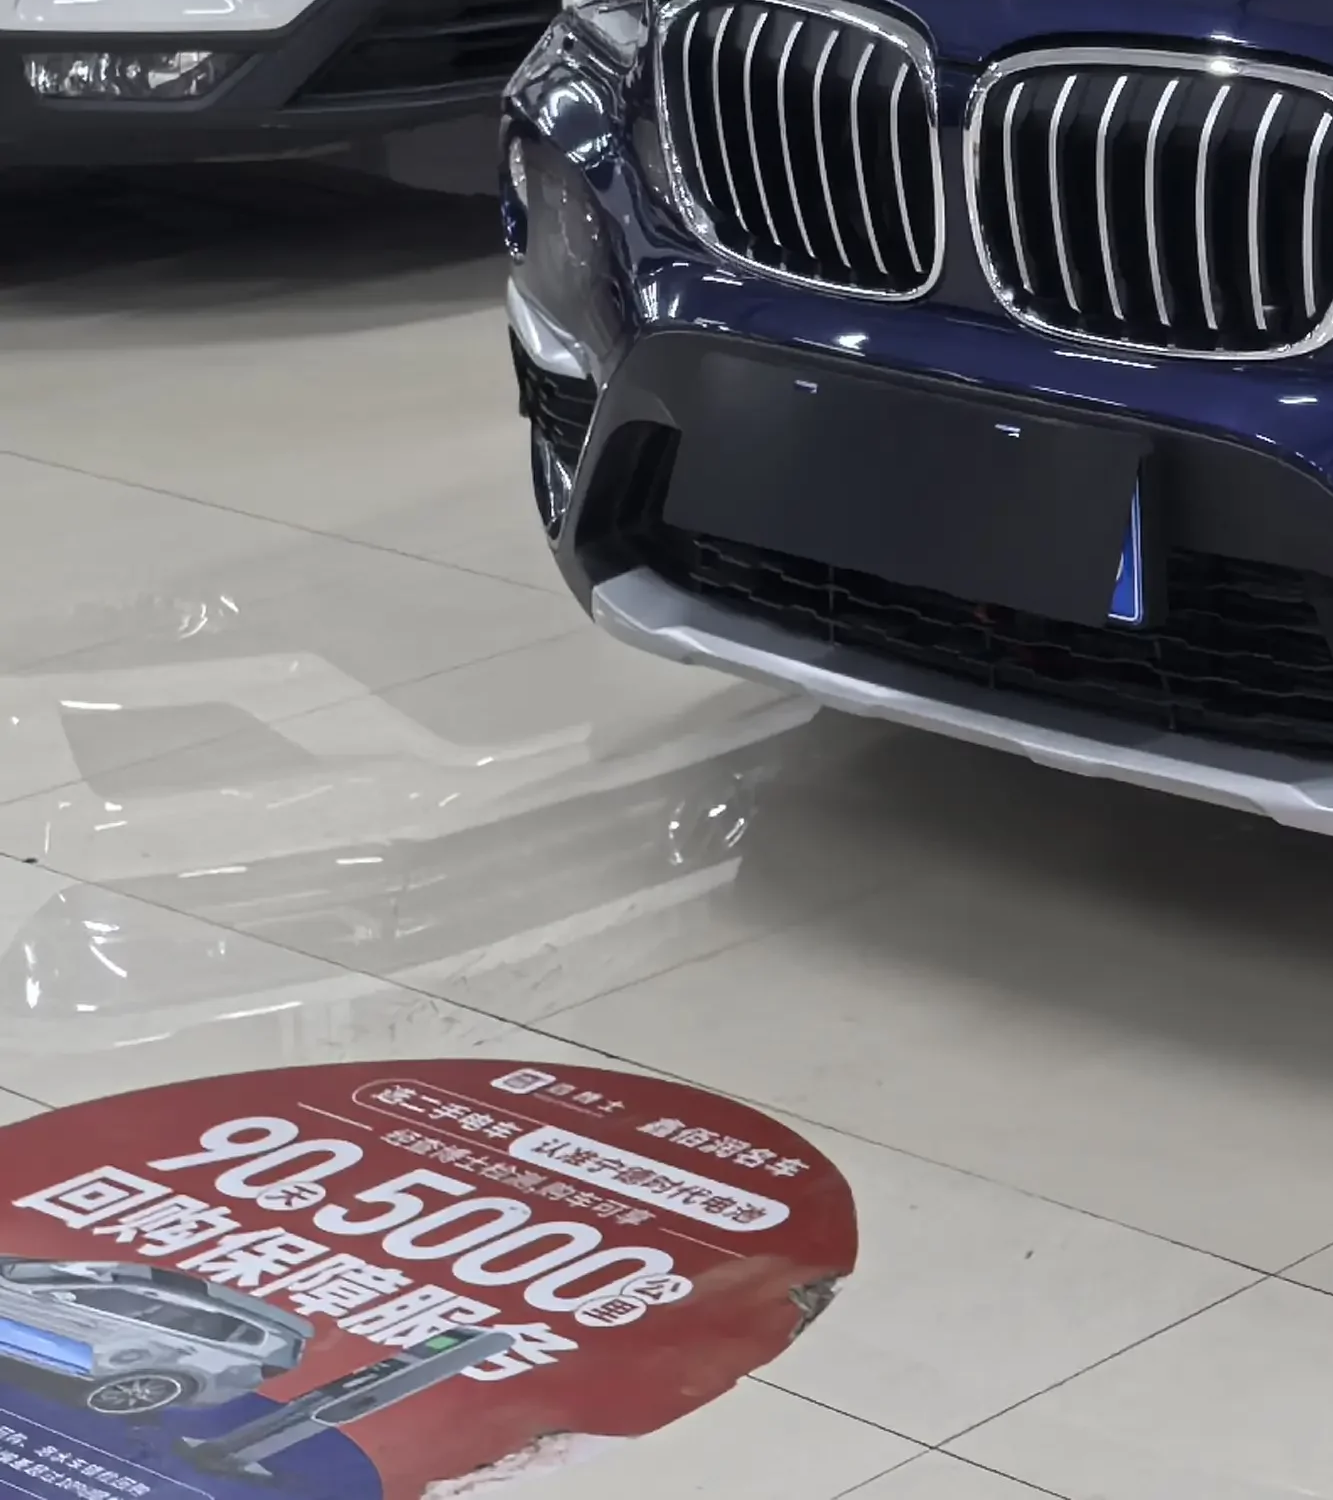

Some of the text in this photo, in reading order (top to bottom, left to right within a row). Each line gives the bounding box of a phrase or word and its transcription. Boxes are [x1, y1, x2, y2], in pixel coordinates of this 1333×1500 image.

[529, 1137, 769, 1224] 认准宁德时代电池
[635, 1117, 811, 1178] 鑫佰润名车
